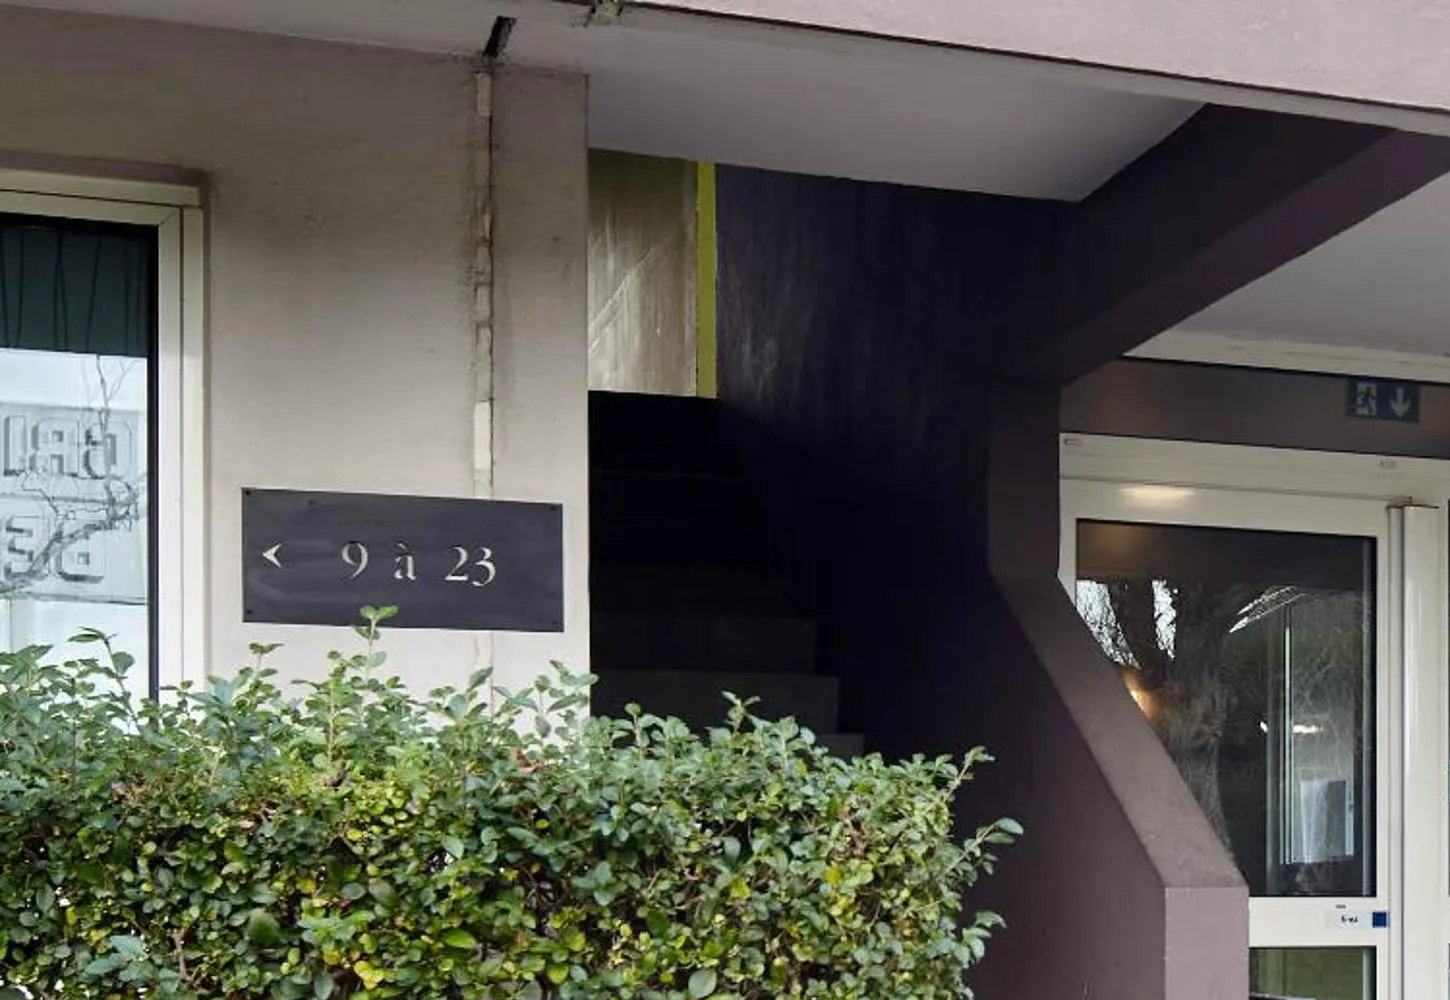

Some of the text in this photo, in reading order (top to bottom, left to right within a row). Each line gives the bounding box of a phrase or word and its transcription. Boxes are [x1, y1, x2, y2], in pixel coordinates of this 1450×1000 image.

[341, 541, 497, 587] 9 à 23
